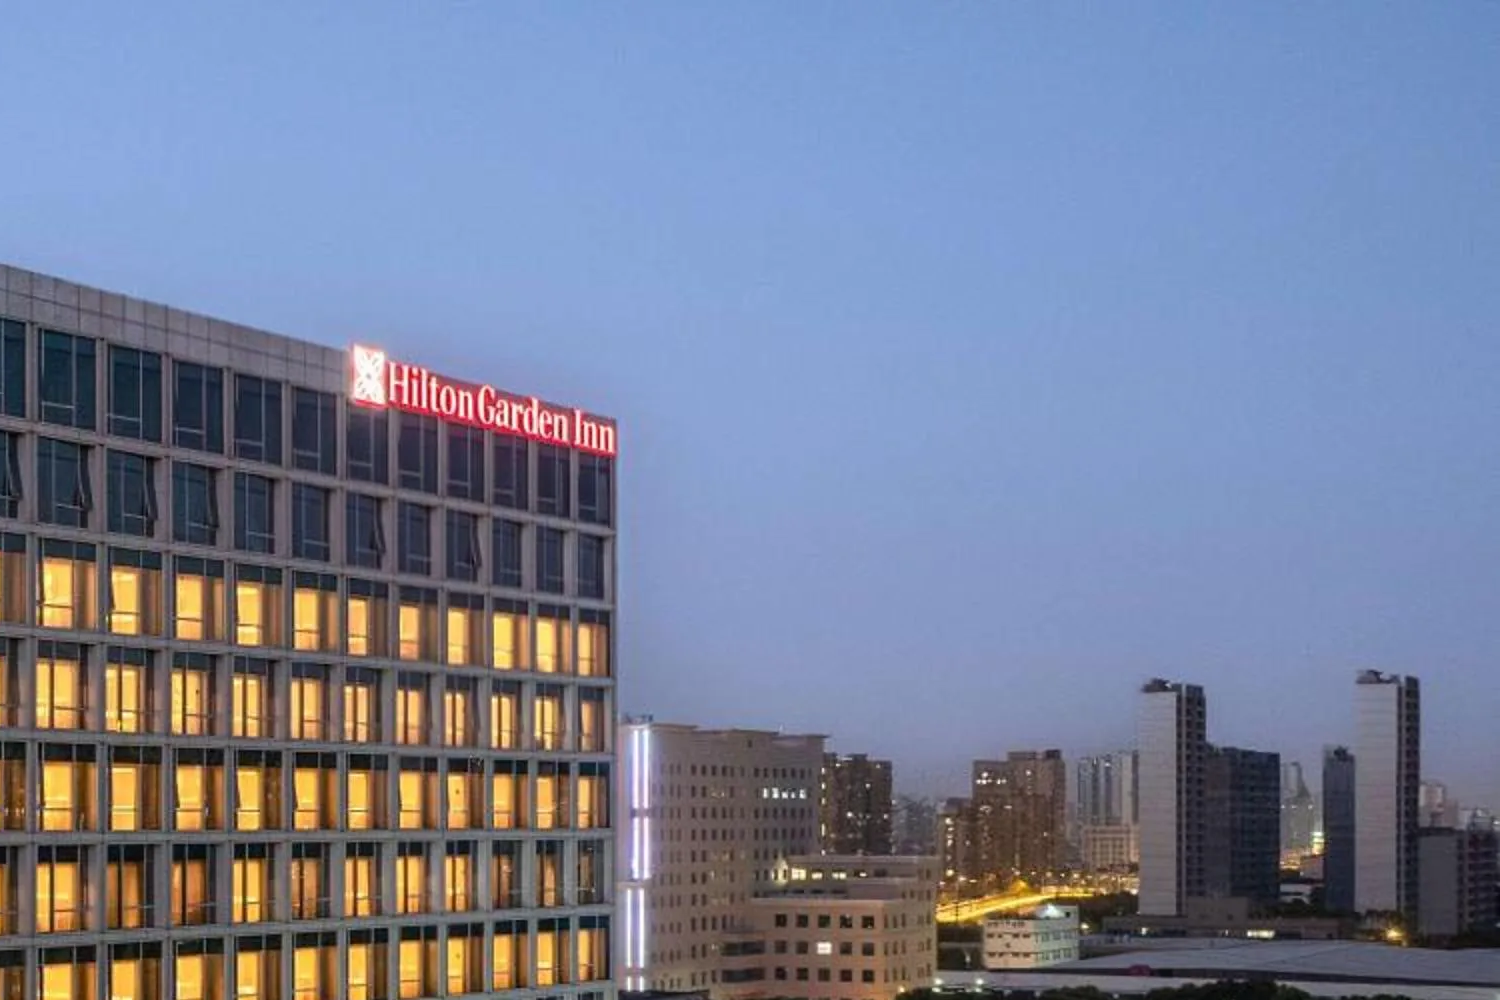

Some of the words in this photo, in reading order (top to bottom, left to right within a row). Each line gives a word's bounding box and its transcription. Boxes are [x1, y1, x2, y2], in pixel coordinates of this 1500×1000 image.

[388, 361, 474, 421] Hilton
[477, 385, 569, 442] Garden
[574, 410, 614, 453] Inn
